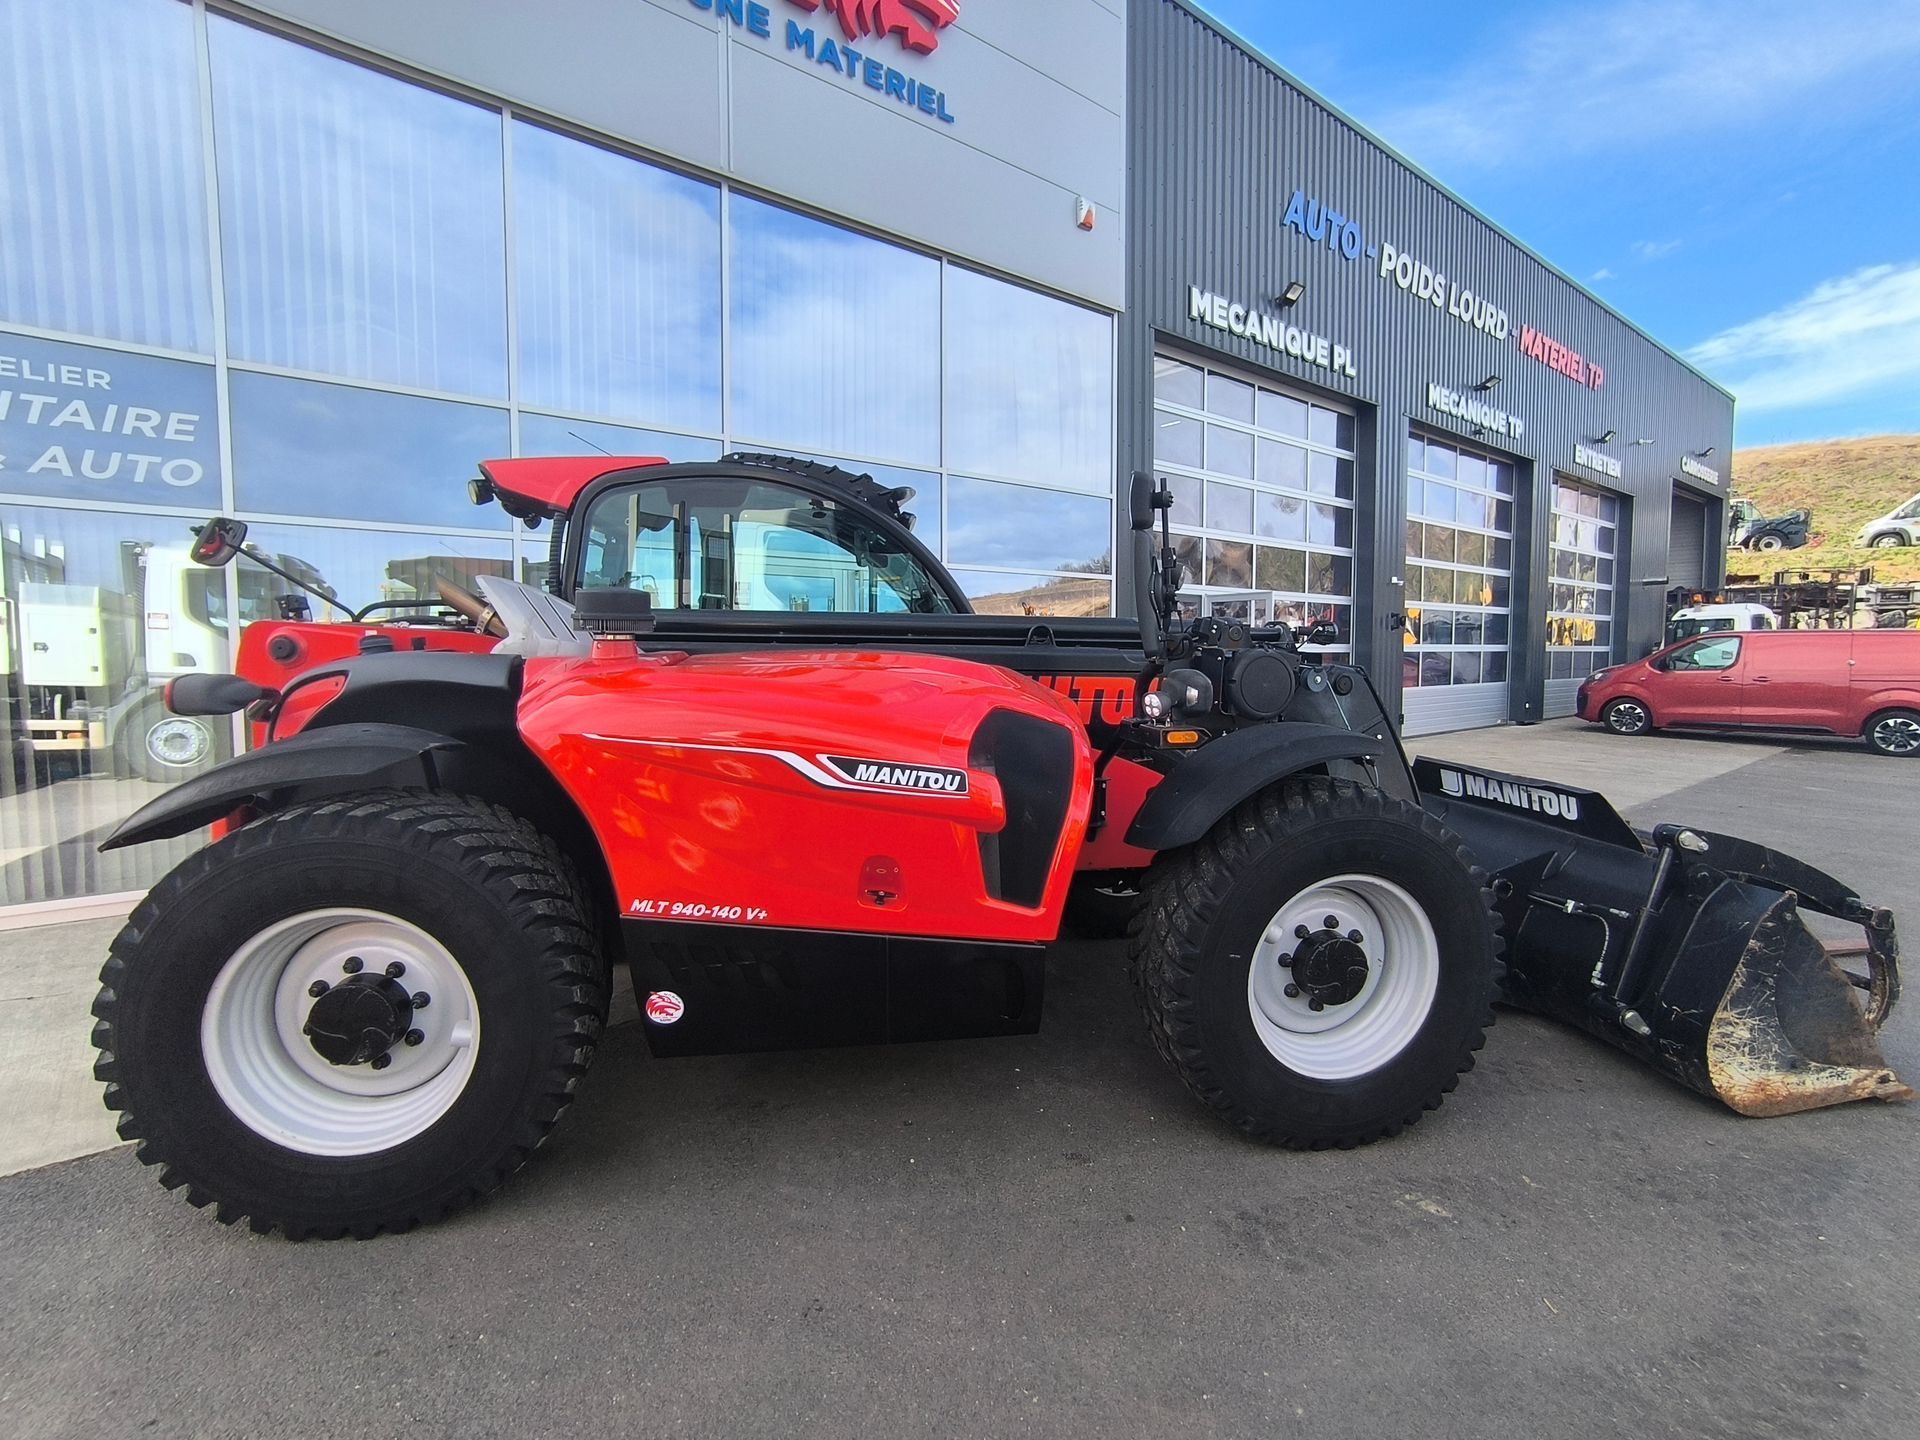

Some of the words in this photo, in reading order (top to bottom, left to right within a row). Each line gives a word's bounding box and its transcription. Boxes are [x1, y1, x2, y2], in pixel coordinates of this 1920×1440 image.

[785, 18, 954, 124] MATERIEL
[1282, 190, 1362, 260] AUTO
[1379, 242, 1446, 308] POIDS
[1448, 282, 1509, 341] LOURD
[1518, 323, 1586, 385] MATERIEL
[1586, 360, 1604, 391] TP
[1189, 286, 1328, 369] MECANIQUE
[1332, 344, 1357, 379] PL
[1427, 382, 1507, 435] MECANIQUE
[1507, 415, 1523, 440] TP
[26, 445, 203, 487] AUTO
[1574, 443, 1621, 479] ENTRETIEN
[855, 763, 961, 791] MANITOU
[1464, 773, 1578, 821] MANITOU
[630, 899, 669, 913] MLT
[670, 902, 742, 919] 940-140
[746, 907, 768, 920] V+
